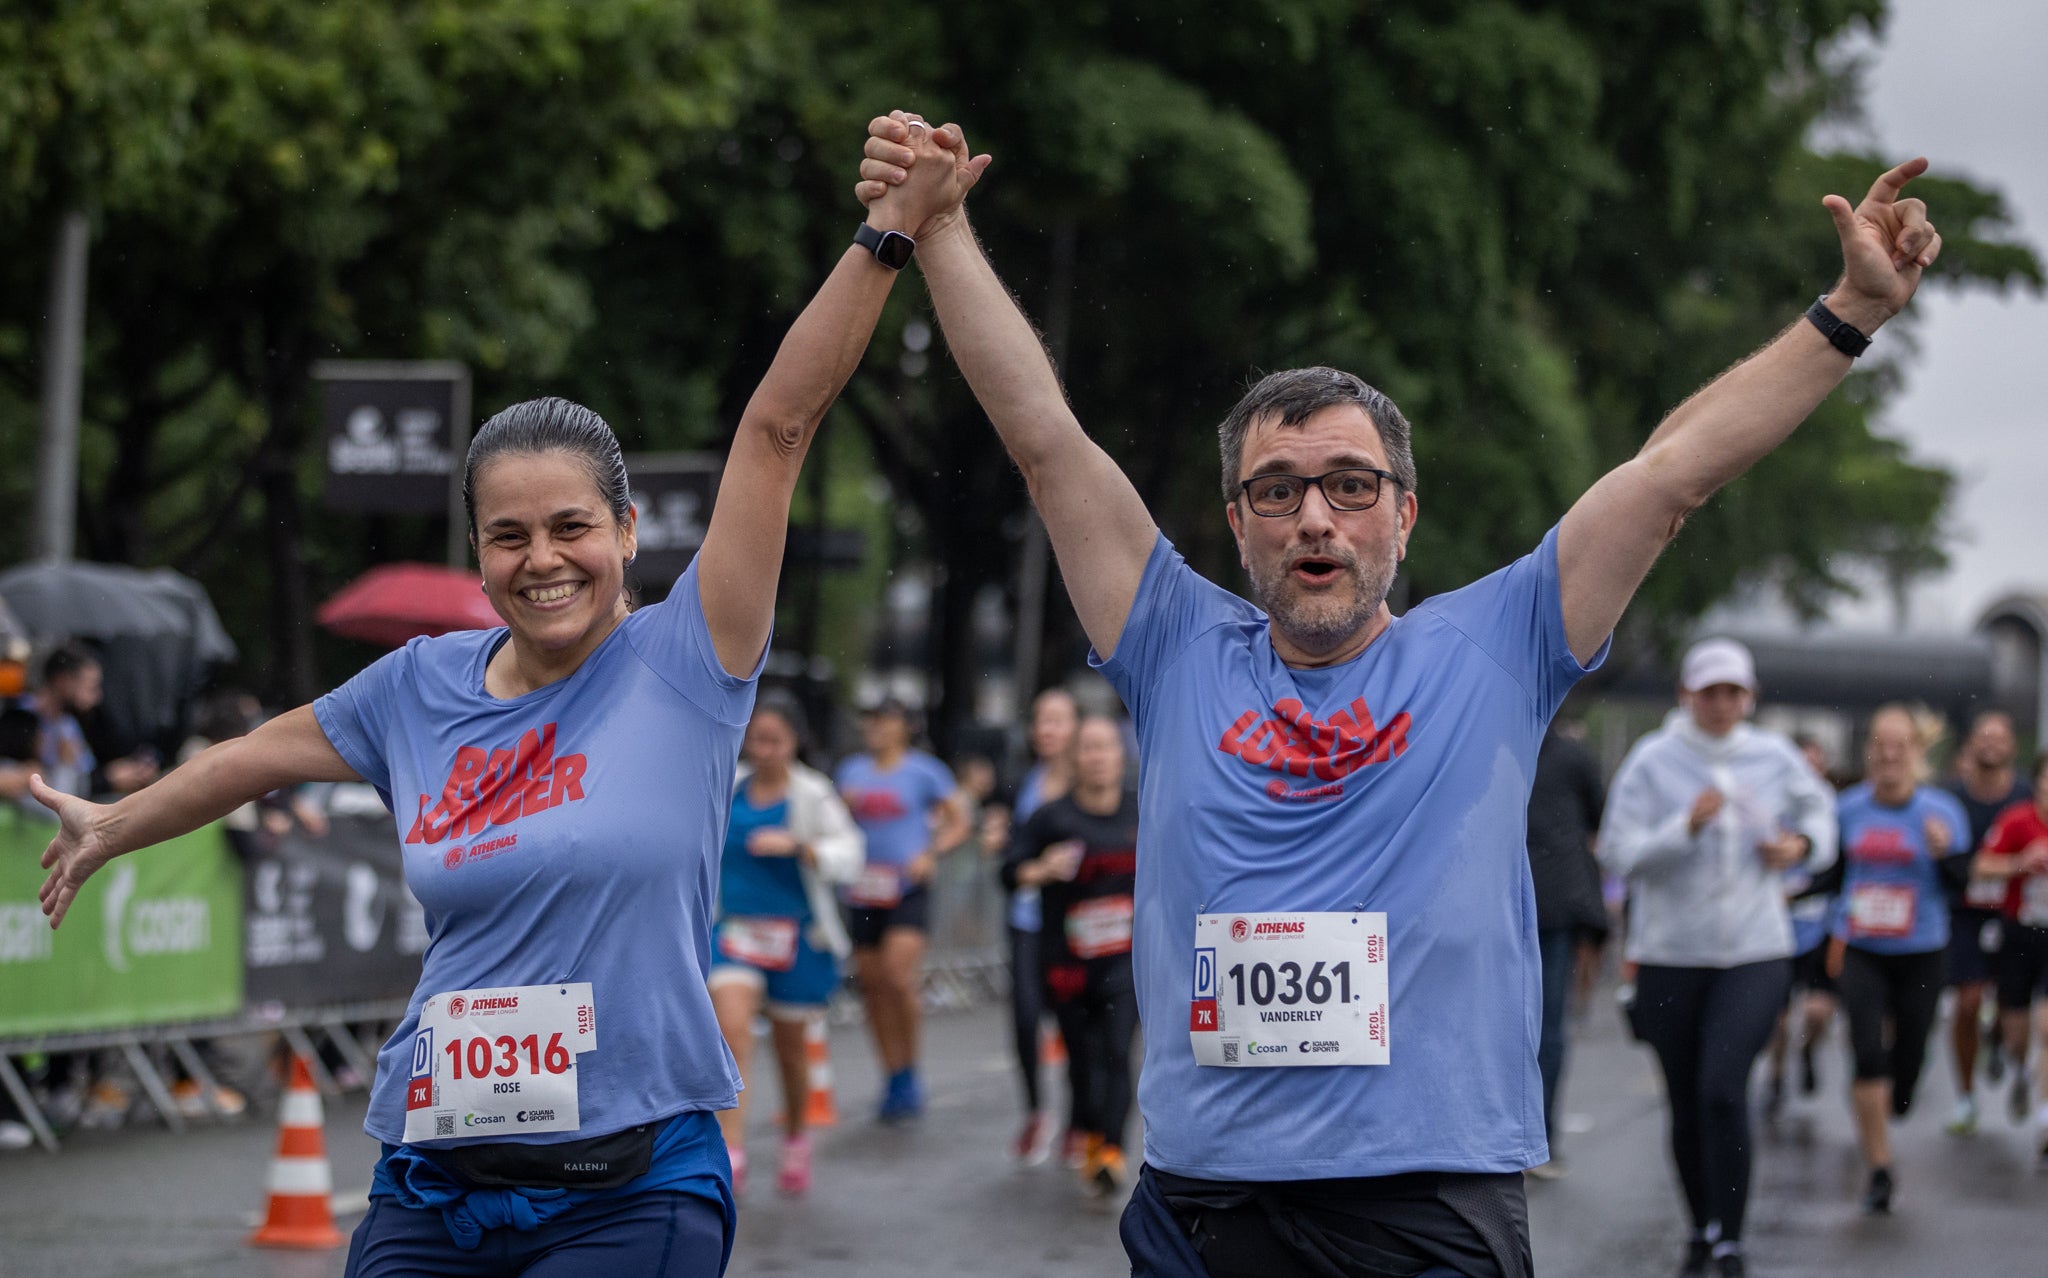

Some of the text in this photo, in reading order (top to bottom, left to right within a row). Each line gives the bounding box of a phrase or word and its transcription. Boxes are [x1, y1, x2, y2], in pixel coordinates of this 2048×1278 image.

[405, 753, 587, 845] LONGER
[469, 834, 518, 858] ATHENAS
[1254, 922, 1305, 934] ATHENAS
[1367, 934, 1378, 964] 10361
[1199, 955, 1211, 992] D
[1229, 961, 1351, 1006] 10361
[471, 997, 519, 1010] ATHENAS
[577, 1005, 588, 1035] 10316
[1198, 1010, 1212, 1024] 7K
[1260, 1010, 1323, 1023] VANDERLEY
[1369, 1011, 1379, 1041] 10361
[415, 1037, 427, 1072] D
[445, 1032, 570, 1080] 10316
[1256, 1043, 1288, 1054] cosan
[414, 1088, 427, 1102] 7K
[493, 1082, 521, 1094] ROSE
[474, 1114, 505, 1124] cosan
[564, 1163, 608, 1171] KALENJI
